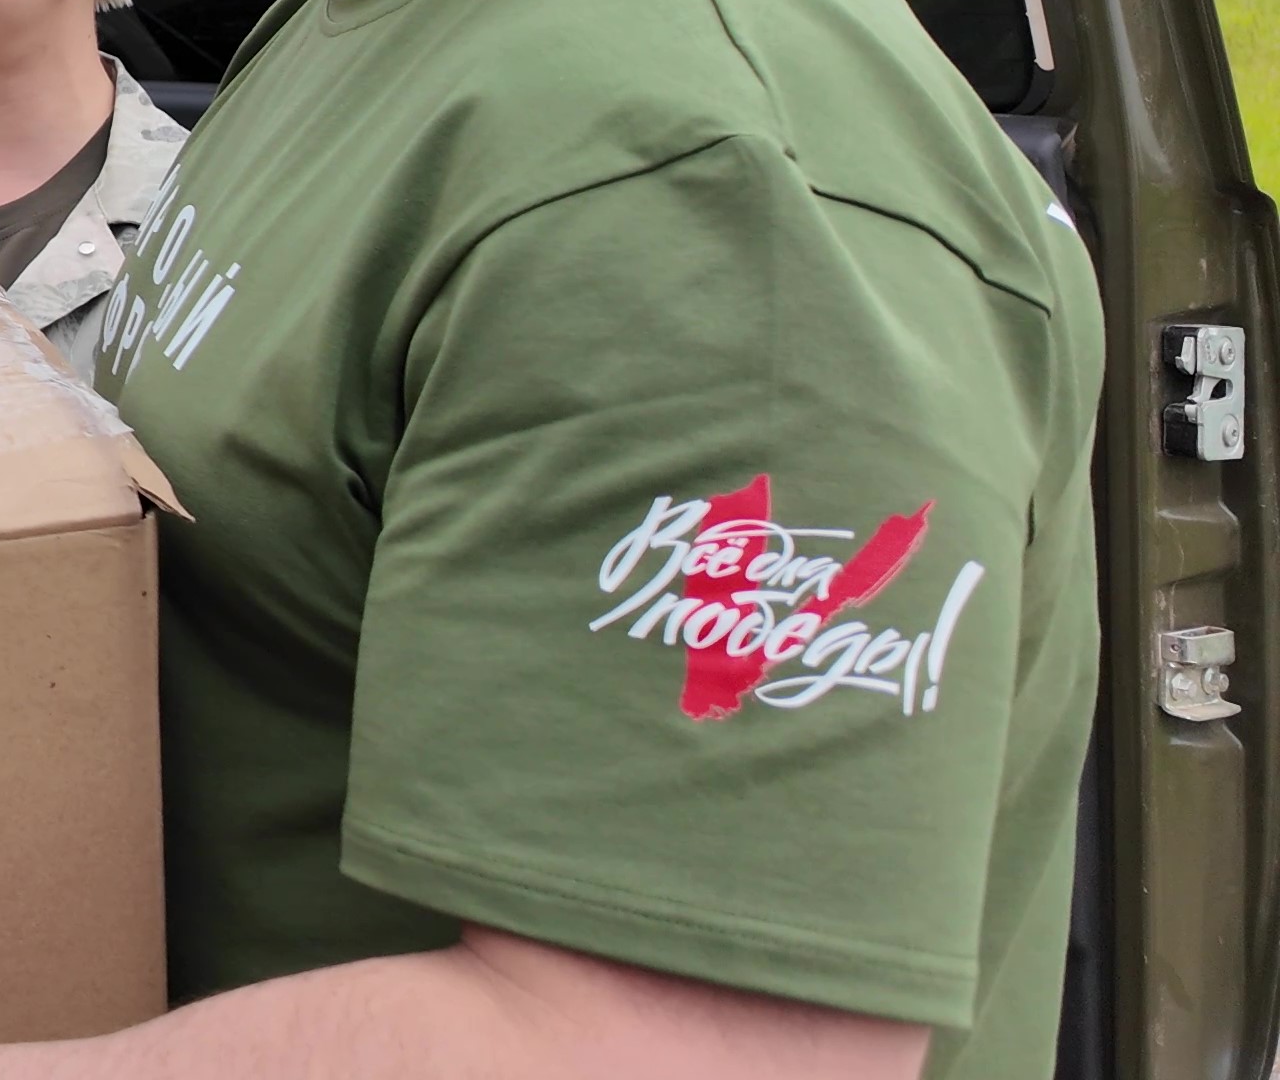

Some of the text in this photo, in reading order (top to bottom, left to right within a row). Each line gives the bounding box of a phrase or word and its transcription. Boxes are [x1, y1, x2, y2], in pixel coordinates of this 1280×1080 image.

[589, 495, 855, 631] Всё для
[627, 560, 985, 716] победы!
